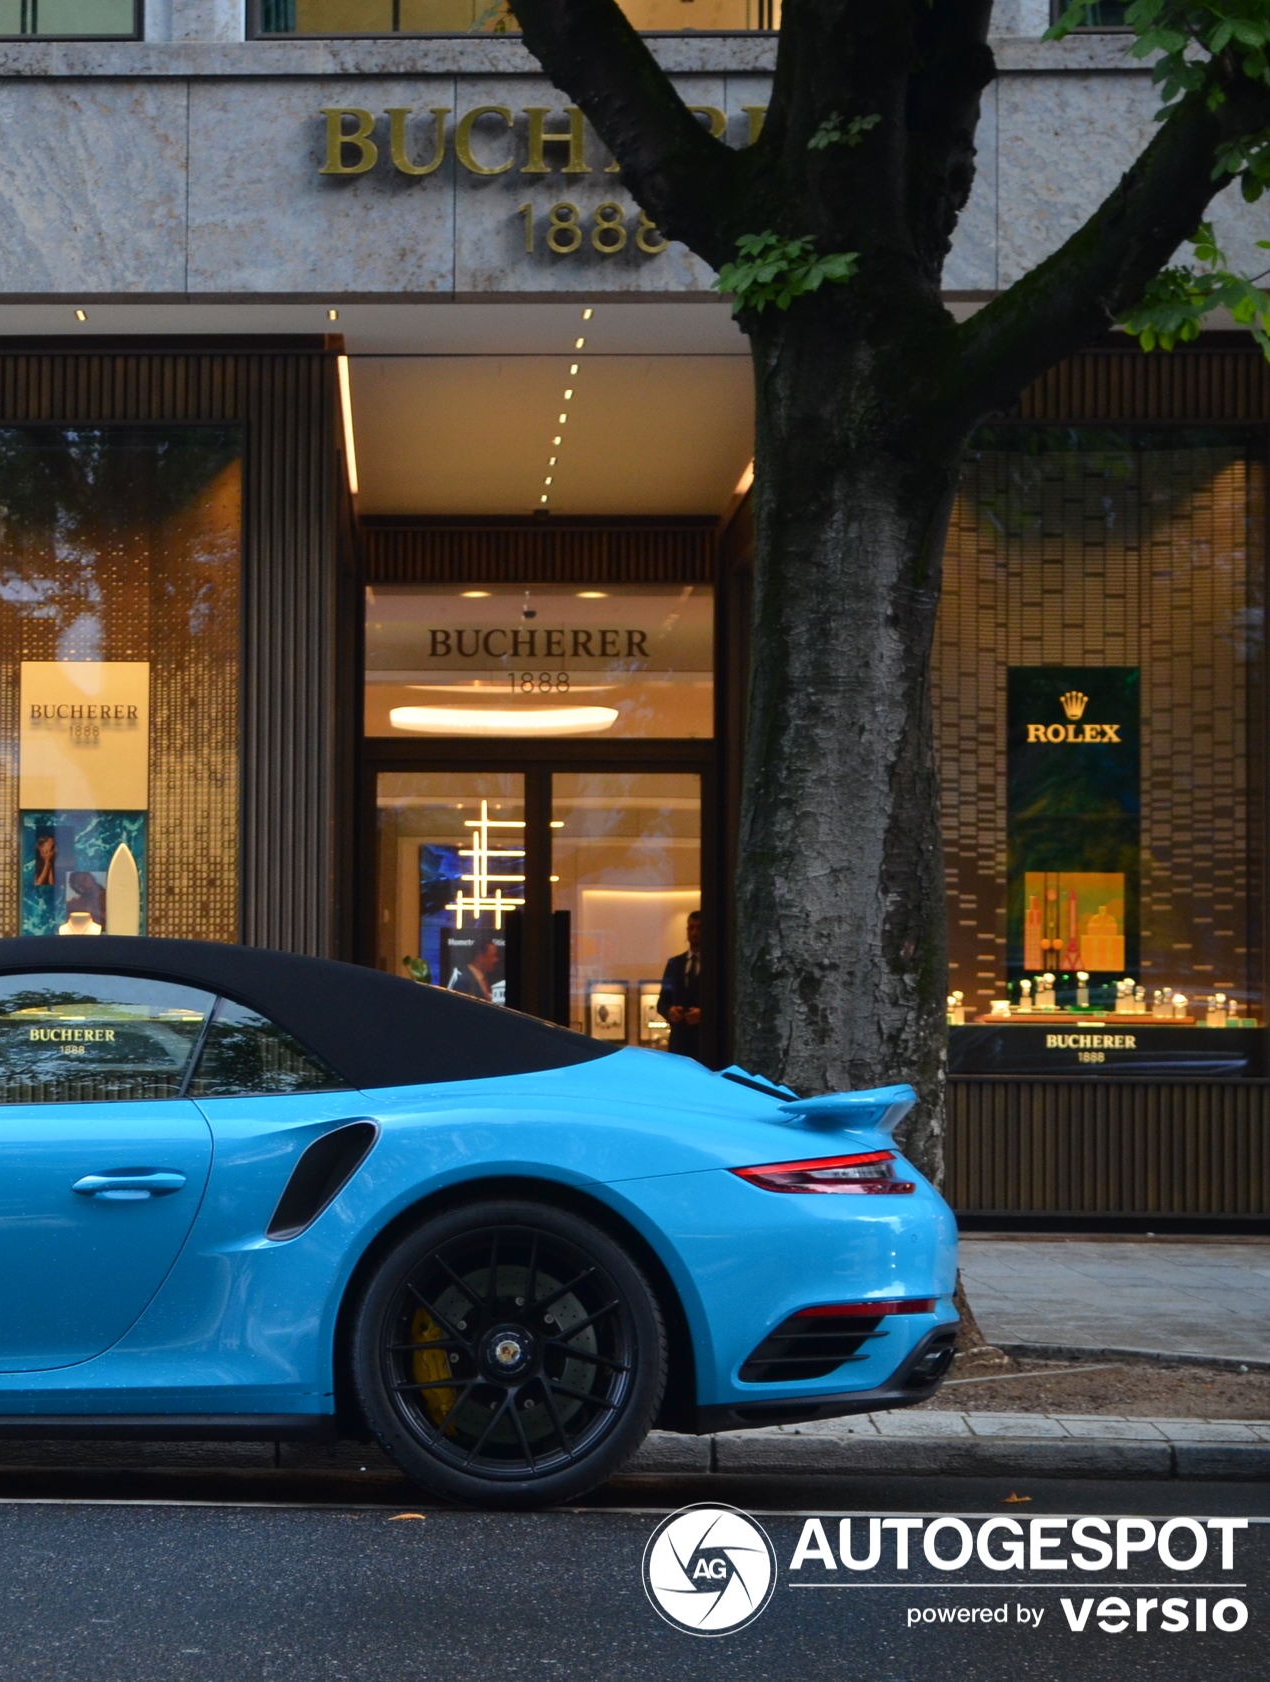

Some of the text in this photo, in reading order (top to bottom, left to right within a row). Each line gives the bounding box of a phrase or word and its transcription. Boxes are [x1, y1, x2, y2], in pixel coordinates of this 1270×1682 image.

[516, 201, 669, 255] 1888
[428, 628, 650, 658] BUCHERER
[508, 672, 570, 693] 1888
[30, 703, 138, 719] BUCHERER
[69, 725, 100, 737] 1888
[1026, 724, 1122, 743] ROLEX
[29, 1029, 116, 1041] BUCHERER
[1046, 1034, 1137, 1049] BUCHERER
[60, 1045, 86, 1055] 1888
[1078, 1052, 1105, 1063] 1888
